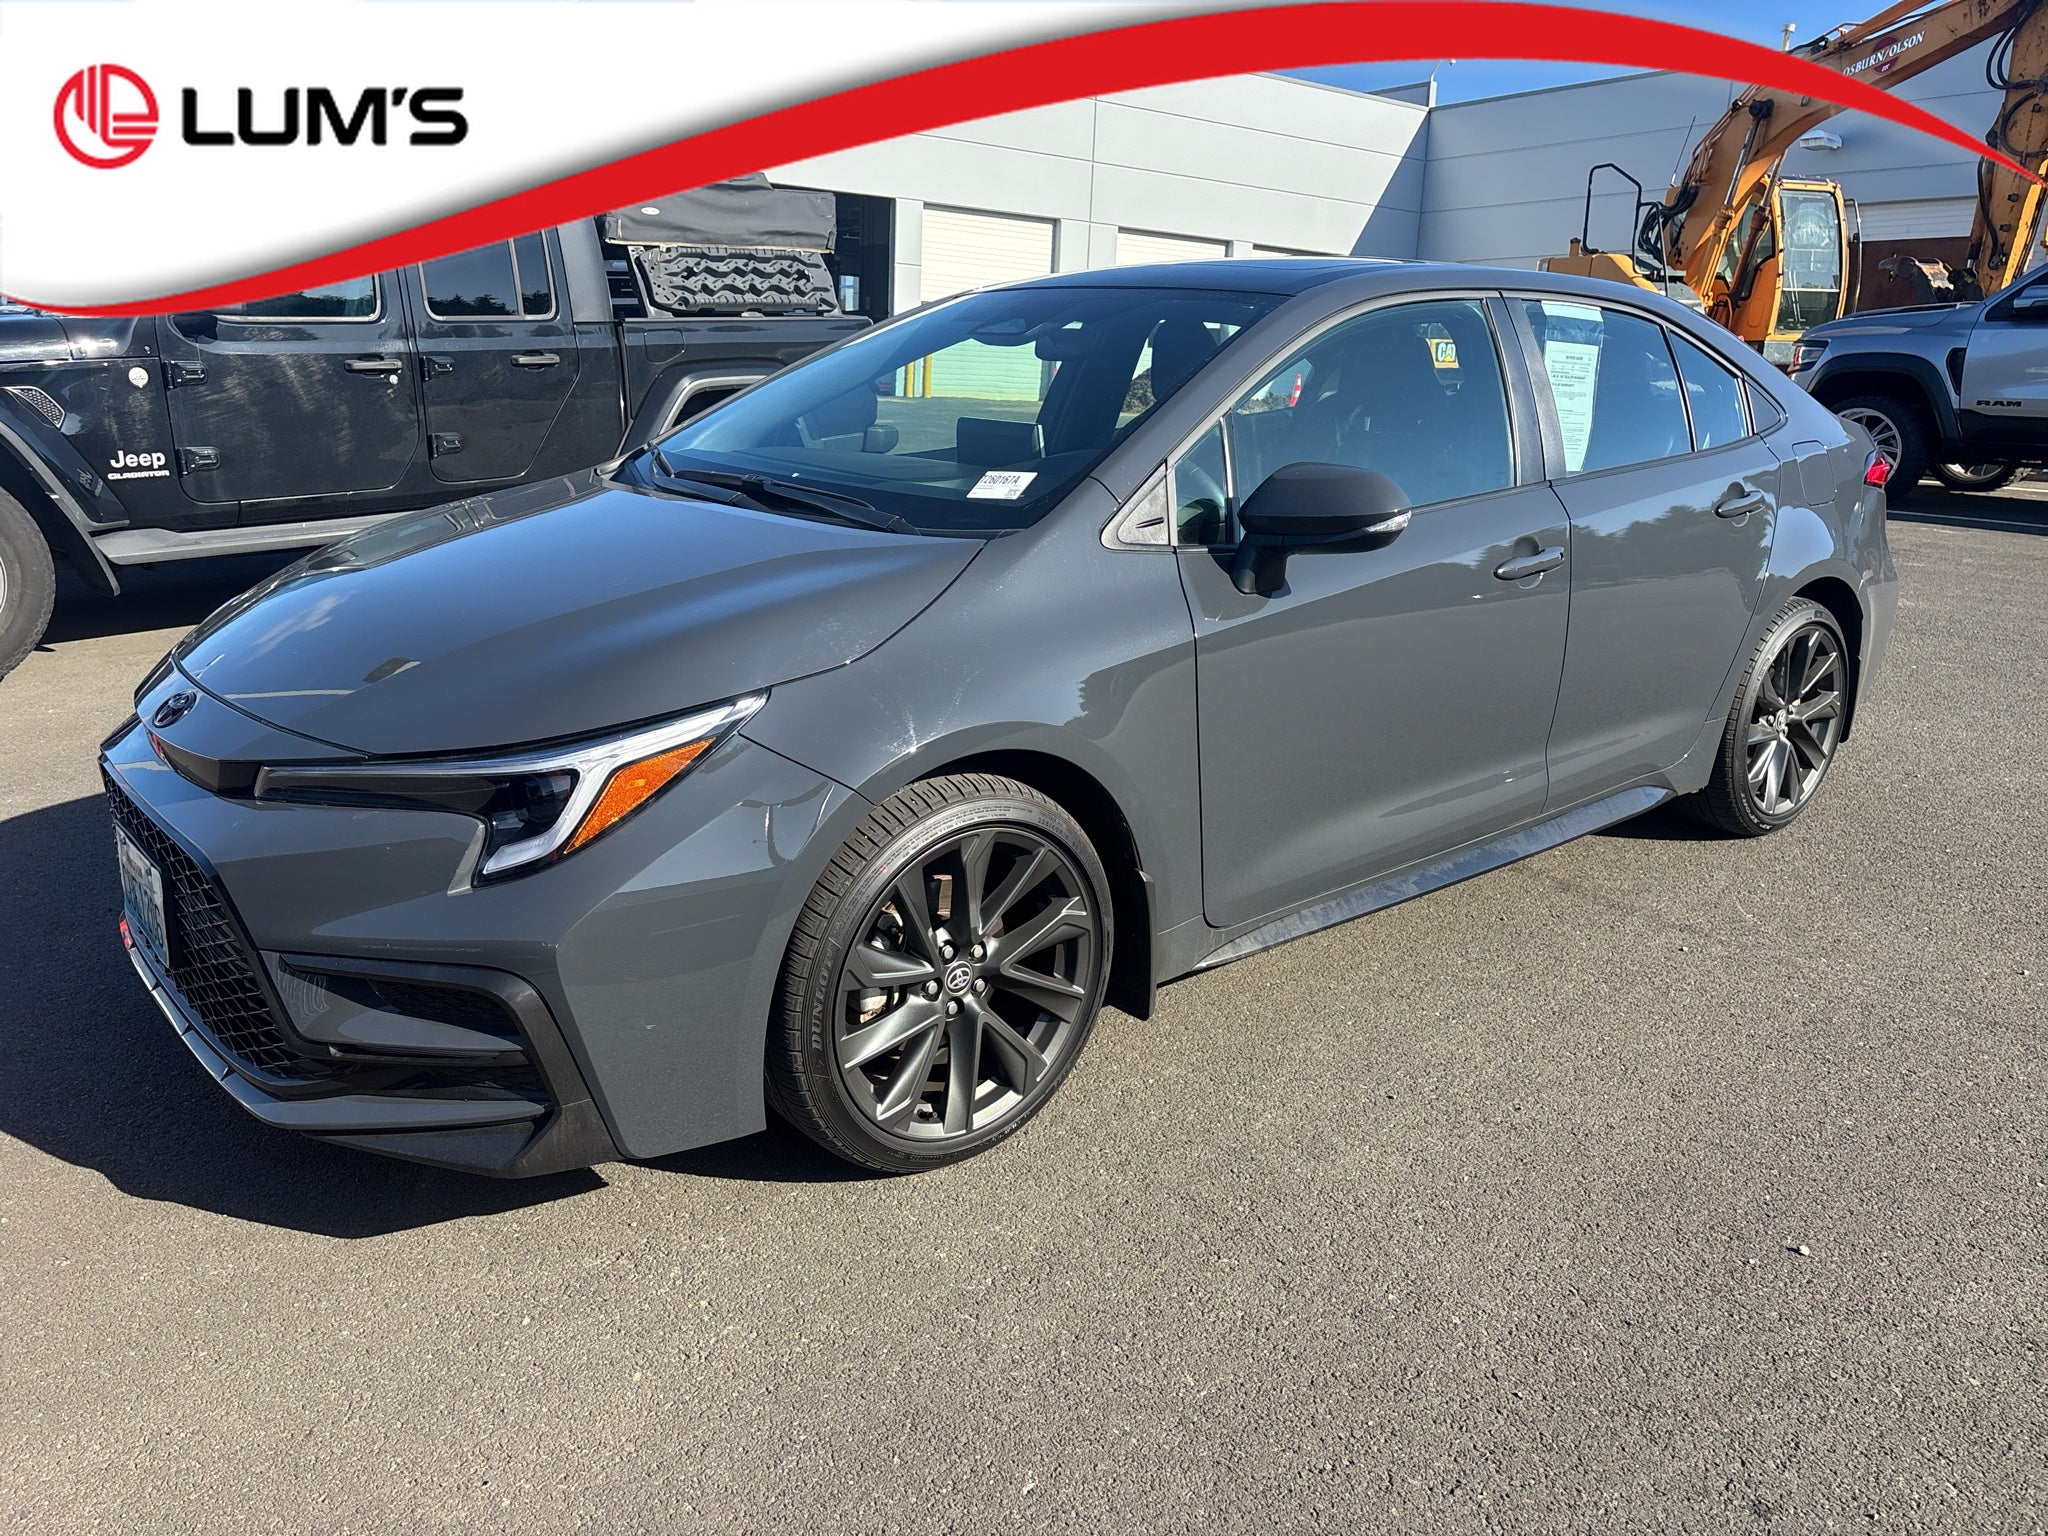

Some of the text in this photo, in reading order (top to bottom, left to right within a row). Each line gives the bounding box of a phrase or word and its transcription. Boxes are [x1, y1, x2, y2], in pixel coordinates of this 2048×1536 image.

[1976, 400, 2022, 408] RAM
[110, 450, 165, 469] Jeep
[107, 470, 170, 481] GLADIATOR
[811, 949, 834, 1050] DUNLOP
